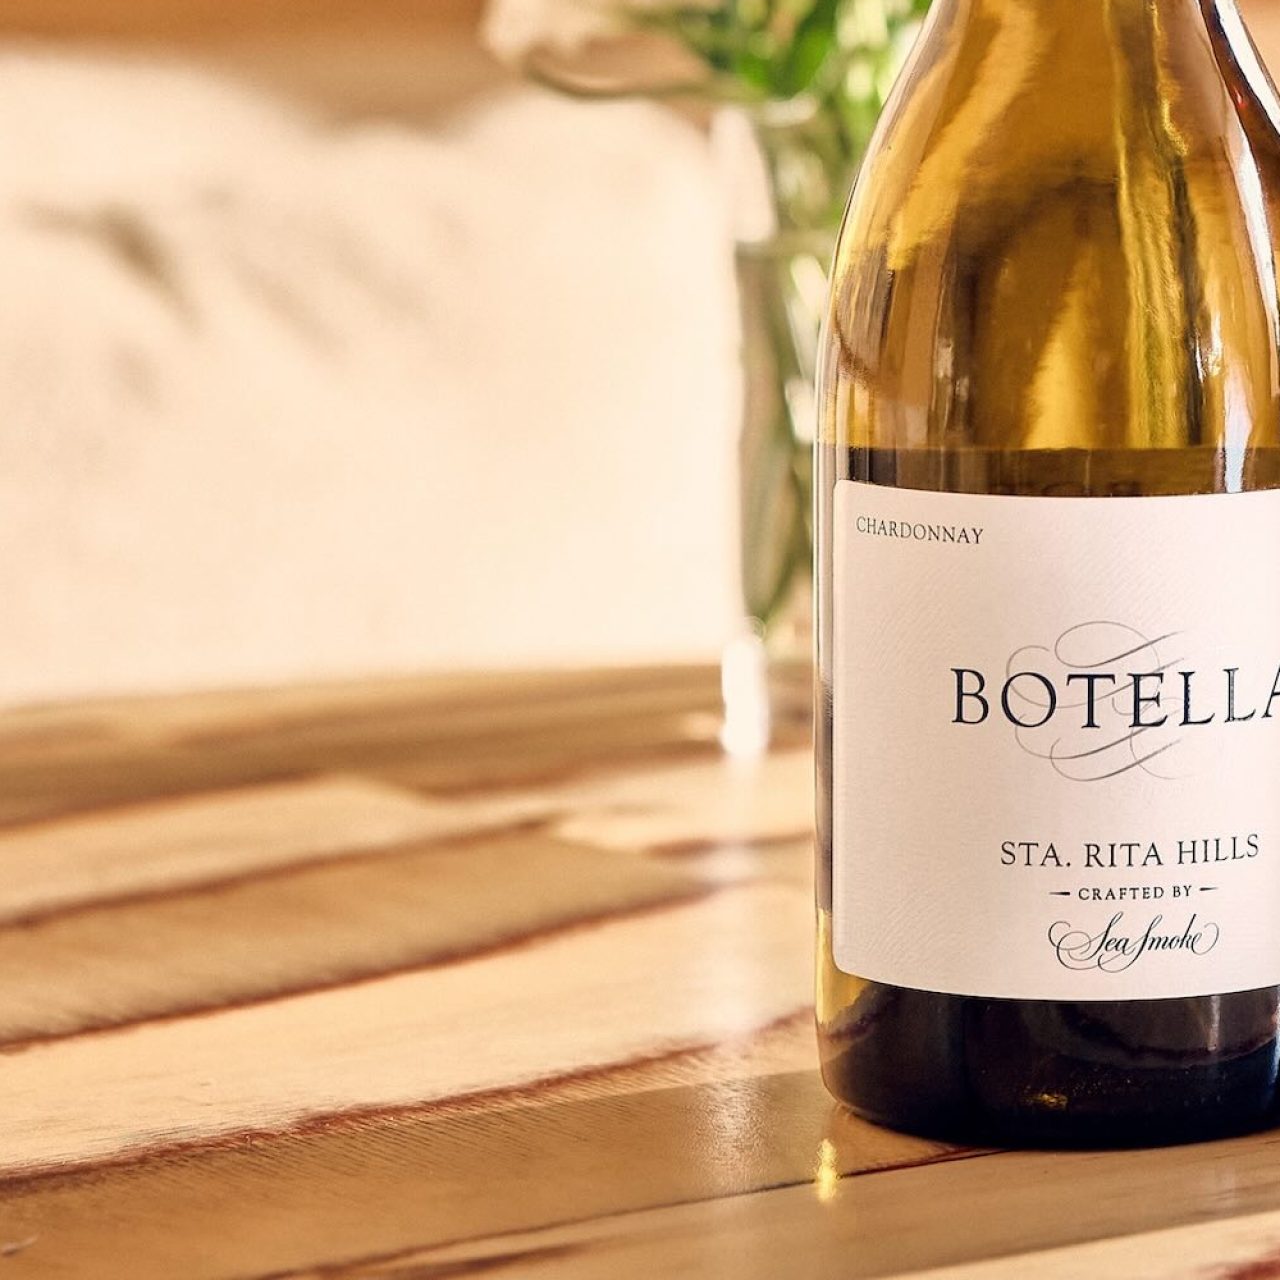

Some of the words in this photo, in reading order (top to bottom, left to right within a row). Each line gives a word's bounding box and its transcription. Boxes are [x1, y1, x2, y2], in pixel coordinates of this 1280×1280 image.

[855, 515, 984, 545] CHARDONNAY
[1000, 841, 1072, 867] STA.
[1084, 842, 1164, 868] RITA
[1177, 834, 1260, 865] HILLS
[1078, 886, 1165, 901] CRAFTED
[1172, 885, 1192, 899] BY
